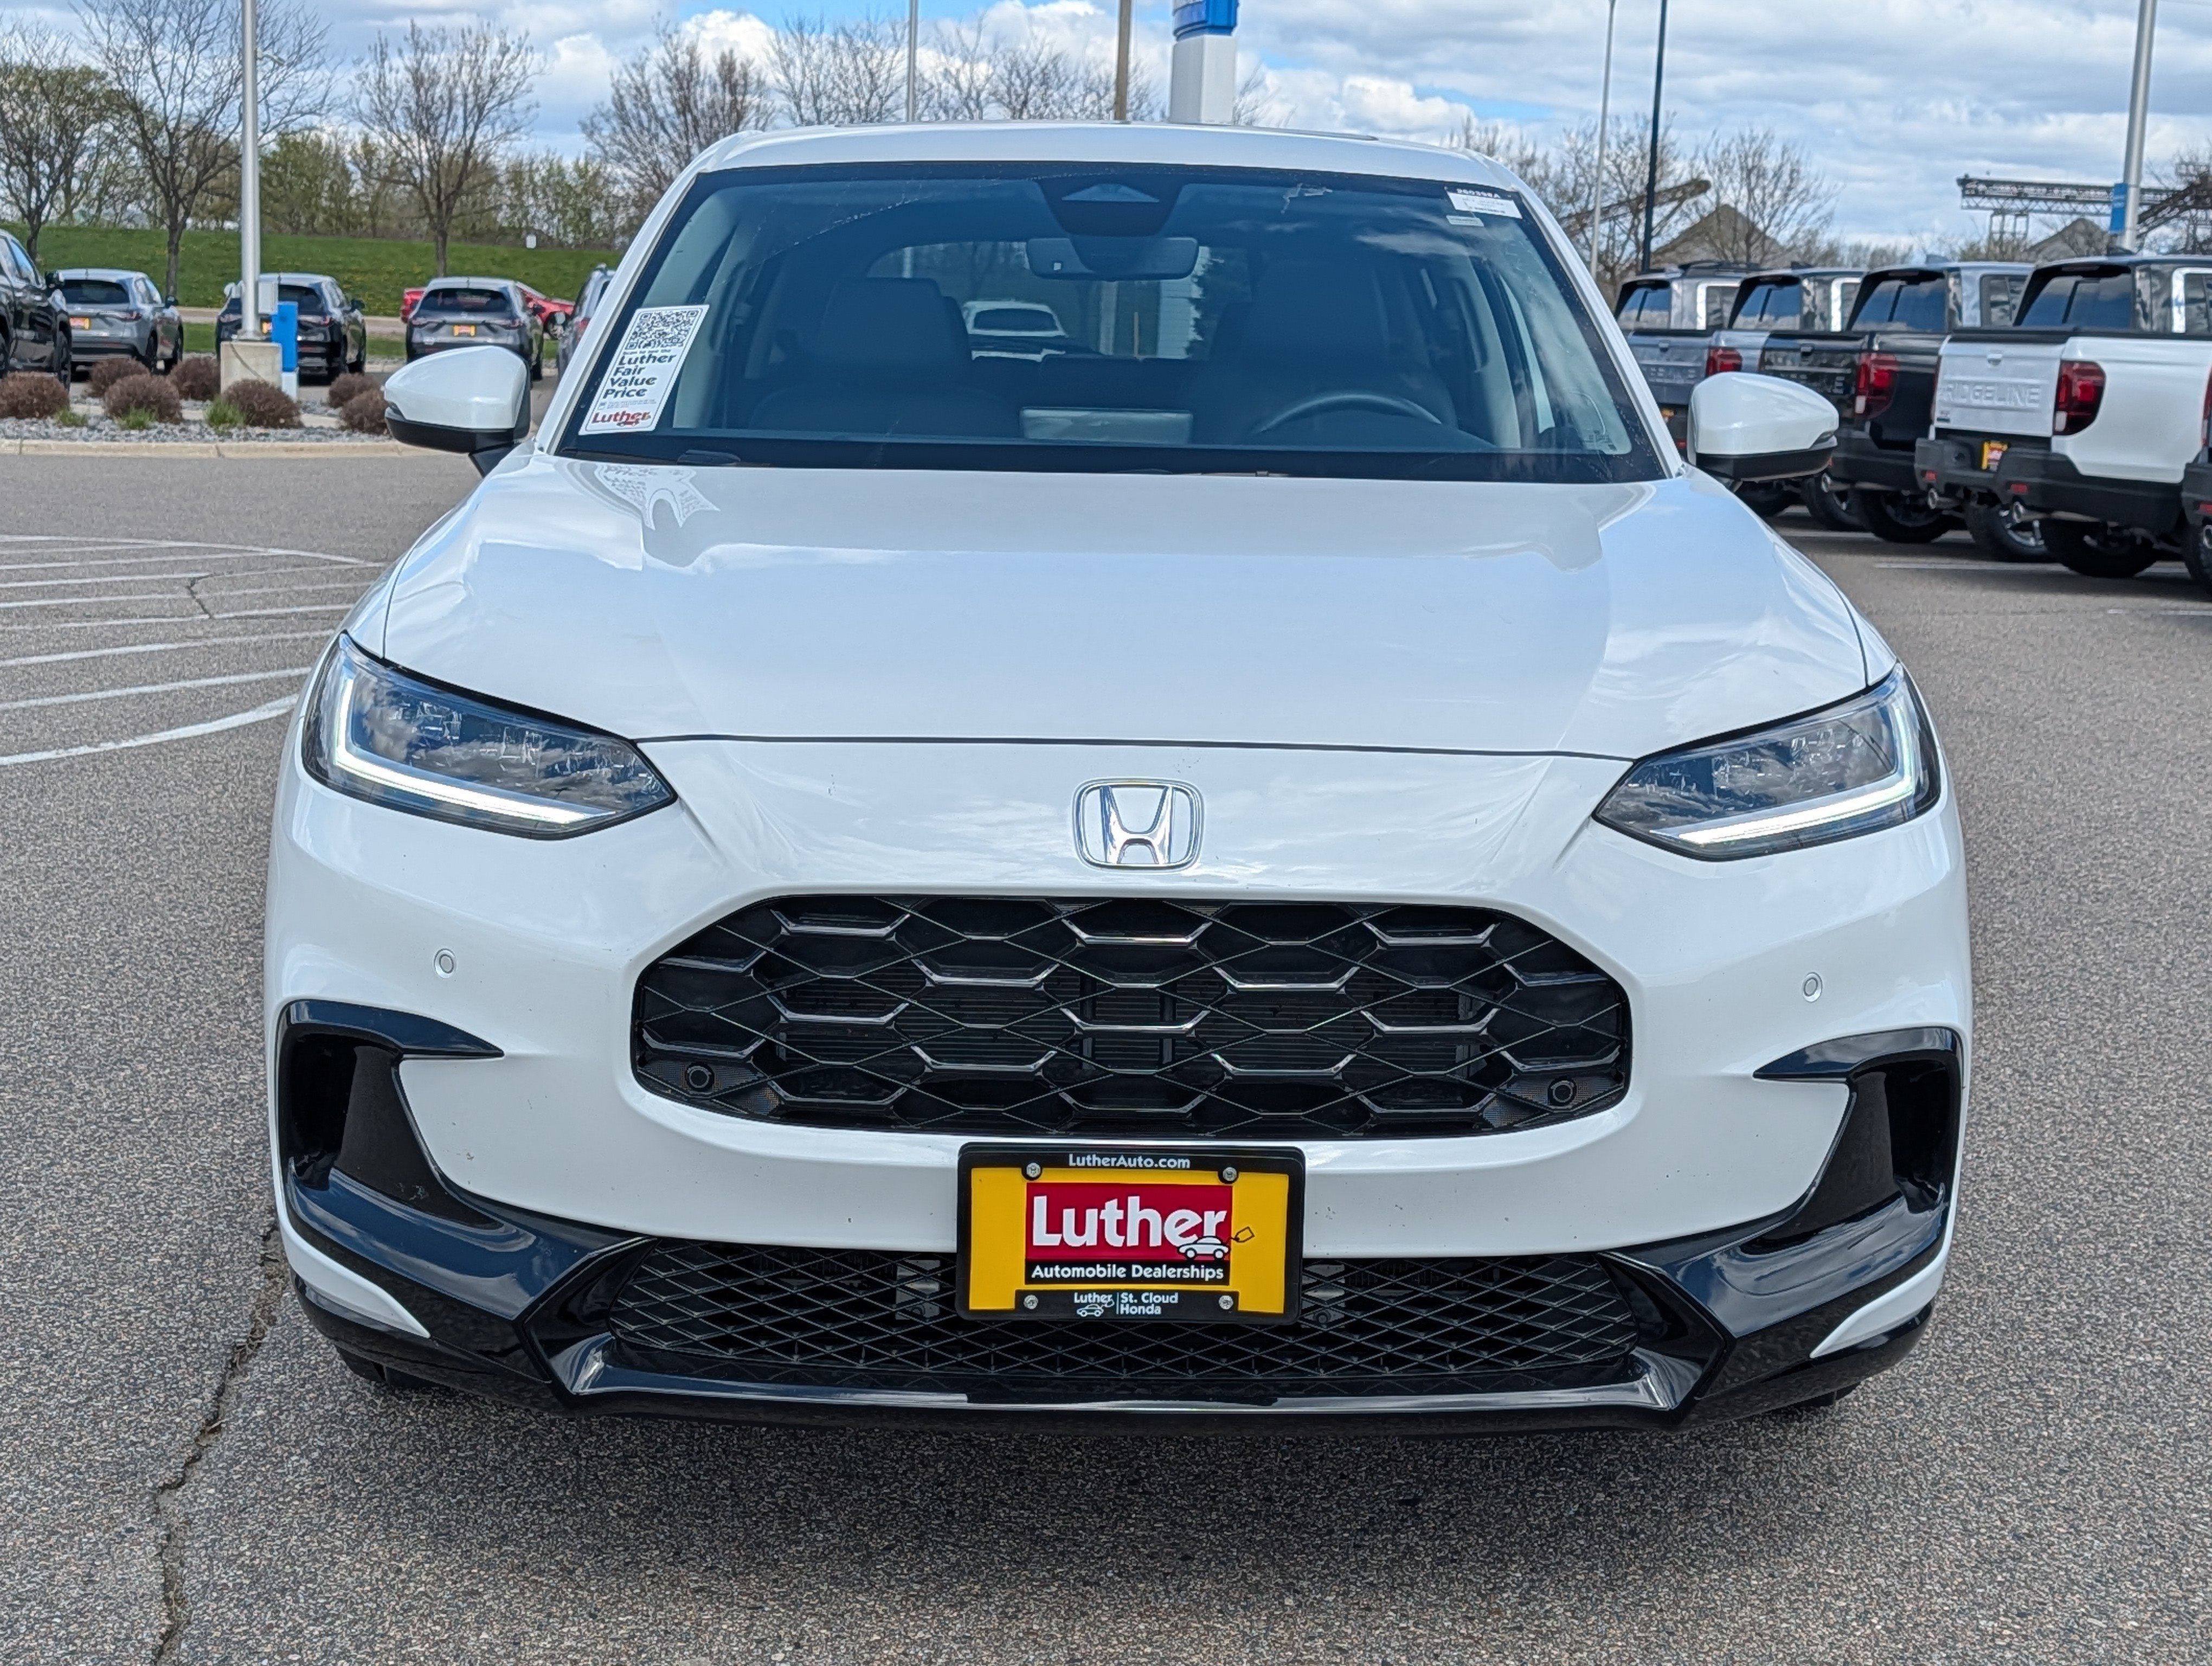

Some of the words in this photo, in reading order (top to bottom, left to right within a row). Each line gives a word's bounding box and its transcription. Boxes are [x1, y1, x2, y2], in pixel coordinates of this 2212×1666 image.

[618, 354, 677, 366] Luther
[613, 365, 646, 376] Fair
[610, 376, 657, 387] Value
[602, 387, 648, 399] Price
[592, 411, 651, 424] Luther
[1069, 1154, 1191, 1169] LutherAuto.com
[1032, 1195, 1227, 1247] Luther
[1031, 1264, 1127, 1279] Automobile
[1131, 1265, 1224, 1281] Dealerships
[1073, 1292, 1113, 1304] Luther
[1120, 1293, 1138, 1304] St.
[1141, 1292, 1179, 1304] Cloud
[1120, 1304, 1161, 1315] Honda
